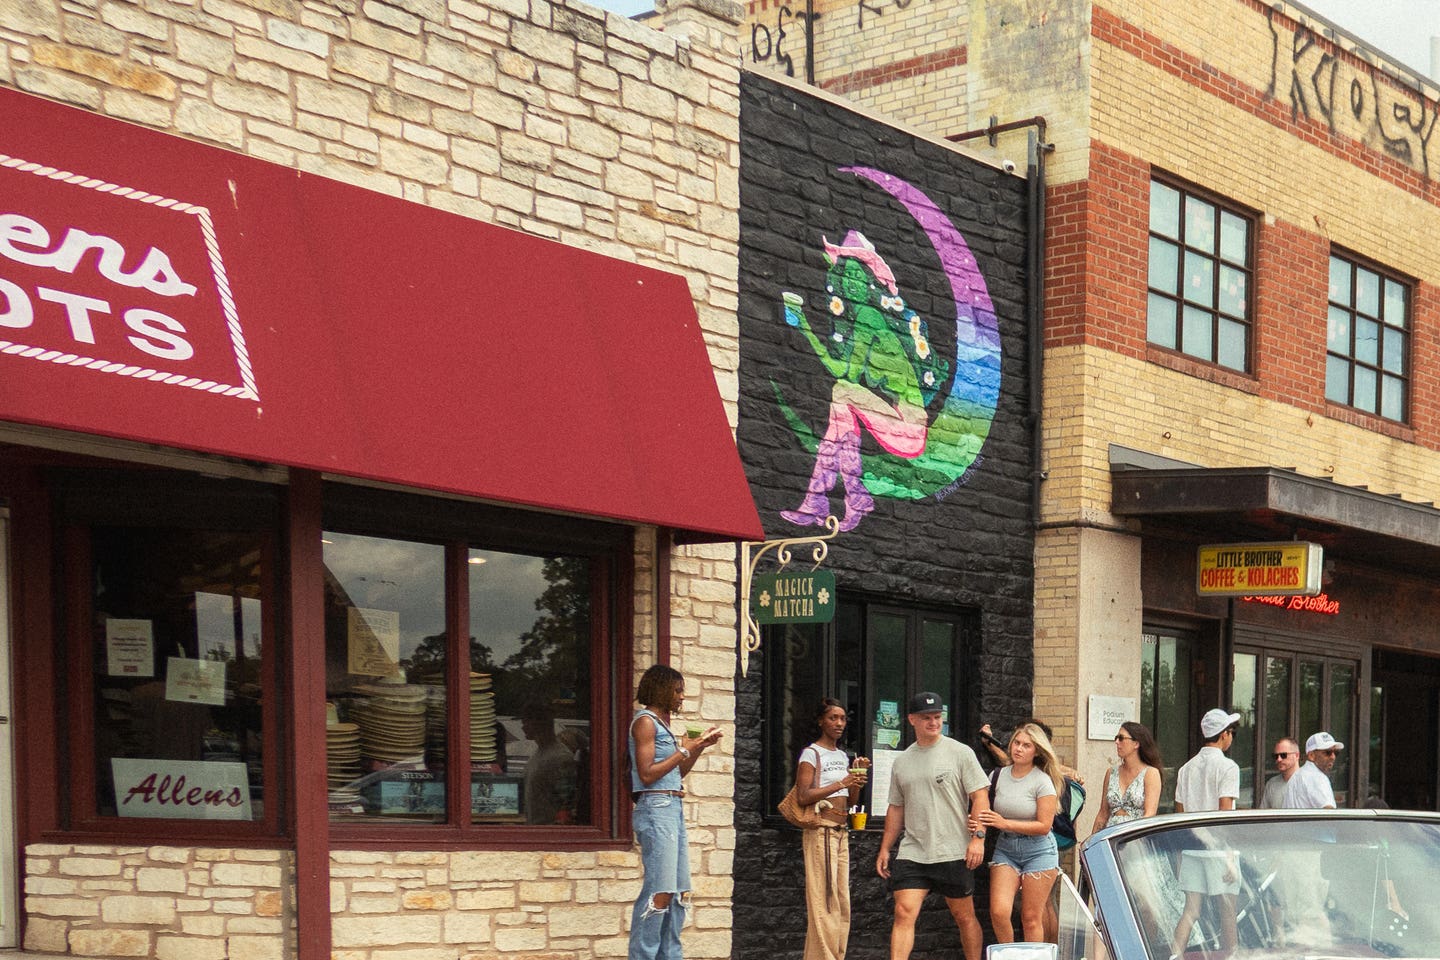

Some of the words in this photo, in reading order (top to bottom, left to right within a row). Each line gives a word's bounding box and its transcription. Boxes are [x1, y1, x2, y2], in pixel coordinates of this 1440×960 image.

[1216, 551, 1242, 567] LITTLE
[1244, 550, 1283, 566] BROTHER
[1200, 568, 1235, 587] COFFEE
[1238, 570, 1245, 583] &
[1247, 566, 1299, 587] KOLACHES
[775, 577, 814, 597] MAGICK
[774, 598, 814, 618] MATCHA
[122, 773, 245, 808] Allens
